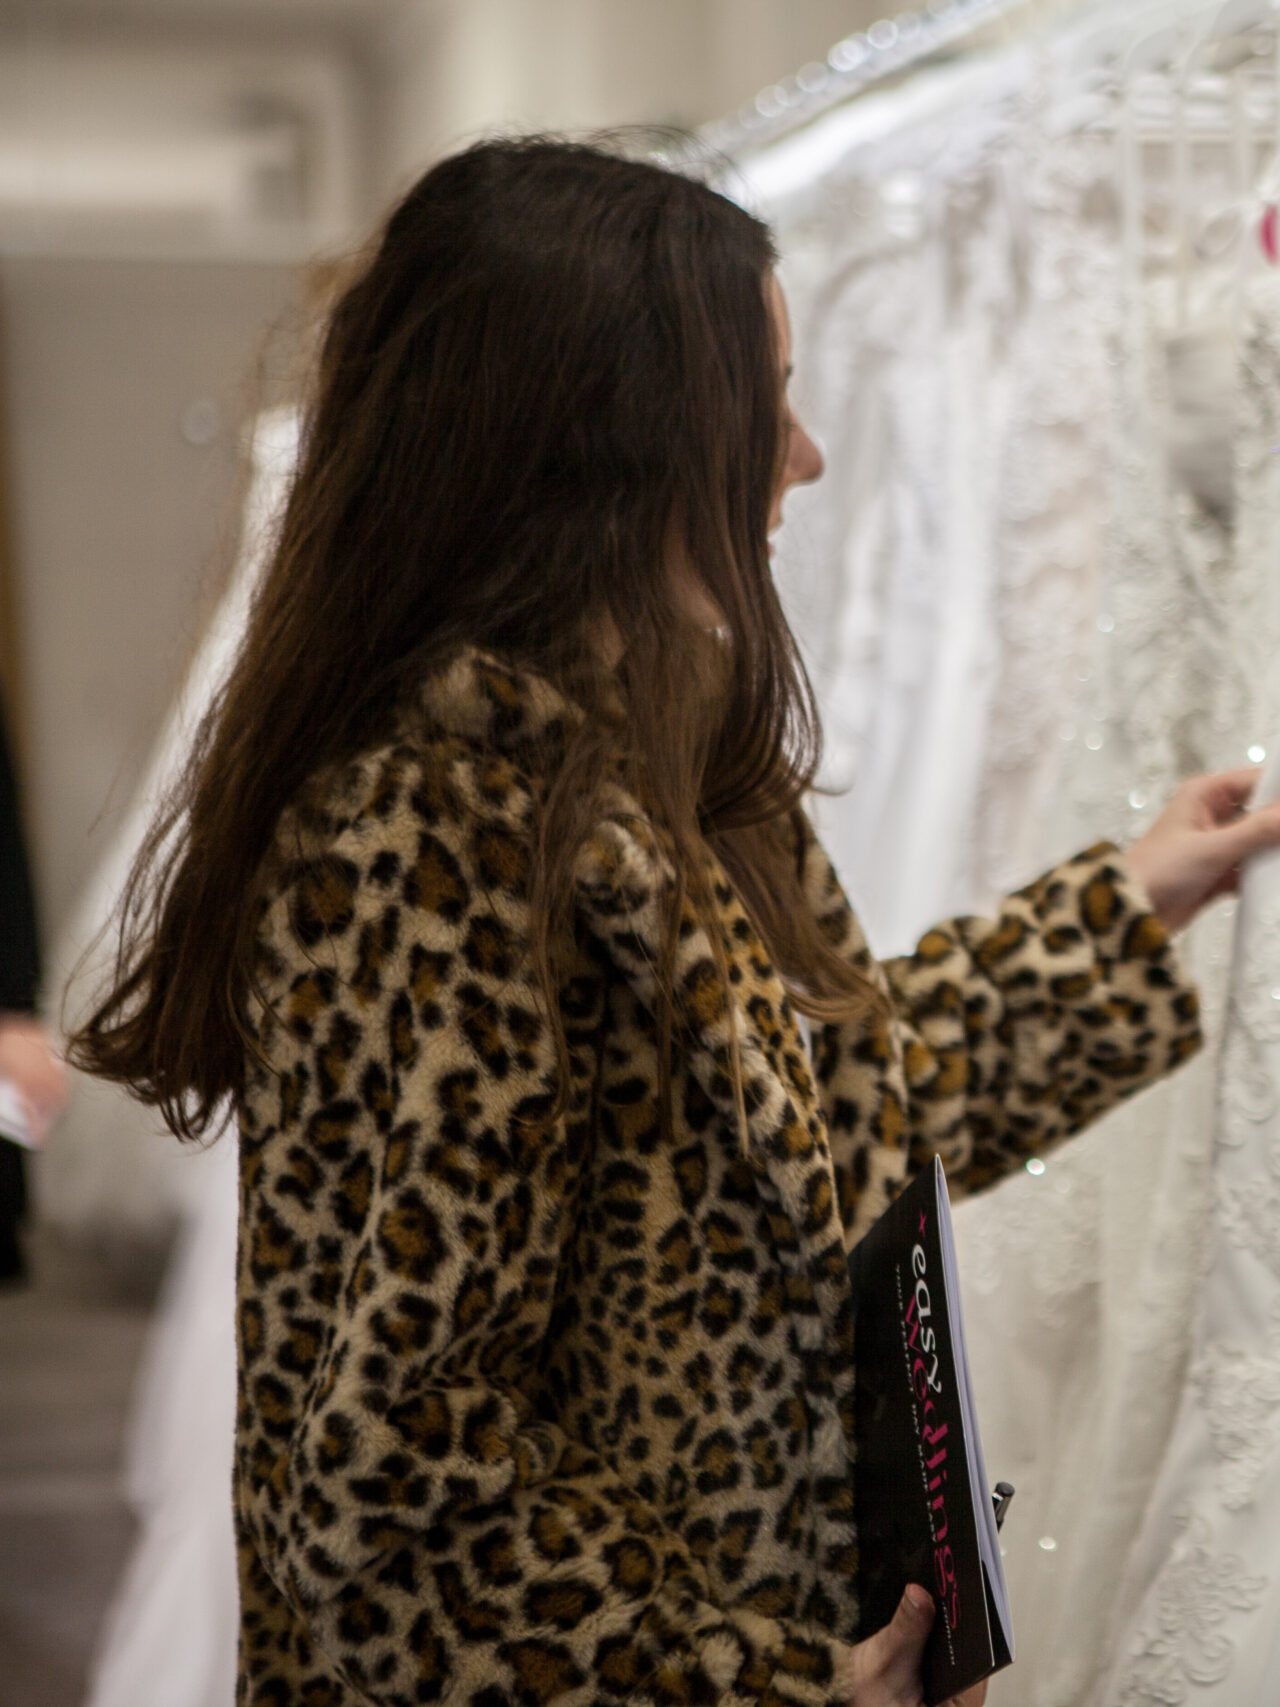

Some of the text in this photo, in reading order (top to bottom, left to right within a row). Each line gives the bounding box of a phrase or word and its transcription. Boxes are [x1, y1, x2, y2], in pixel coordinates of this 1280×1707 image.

[911, 1243, 942, 1394] easy
[900, 1320, 915, 1393] PERFECT
[911, 1403, 921, 1435] DAY
[917, 1443, 930, 1493] MADE
[926, 1500, 938, 1543] EASY
[904, 1295, 958, 1629] weddings
